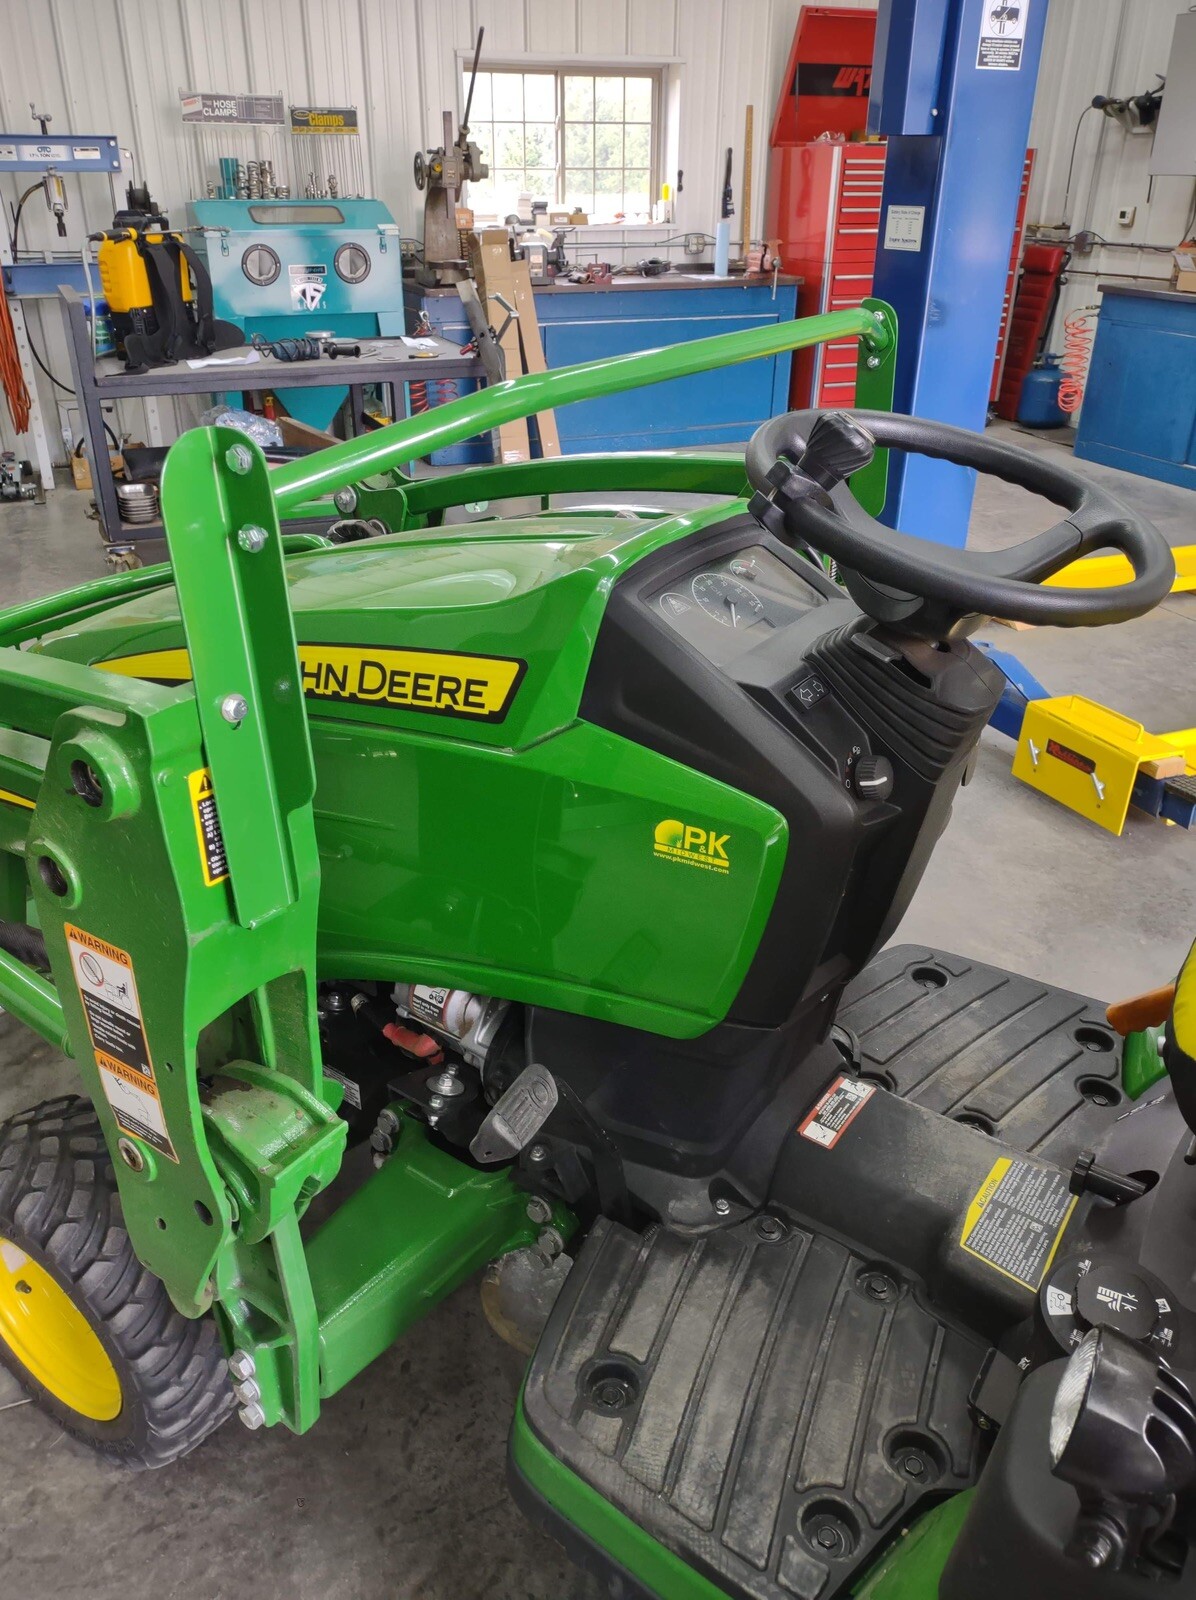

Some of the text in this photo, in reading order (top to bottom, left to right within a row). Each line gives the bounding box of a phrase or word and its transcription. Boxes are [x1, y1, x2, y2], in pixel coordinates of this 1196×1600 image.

[203, 108, 238, 117] CLAMPS
[213, 100, 237, 109] HOSE
[309, 112, 344, 126] Clamps
[301, 660, 489, 709] HN DEERE
[653, 851, 729, 875] www.pkmidwest.com
[77, 931, 128, 965] WARNING
[107, 1062, 155, 1095] WARNING
[980, 1178, 998, 1204] CAUTION
